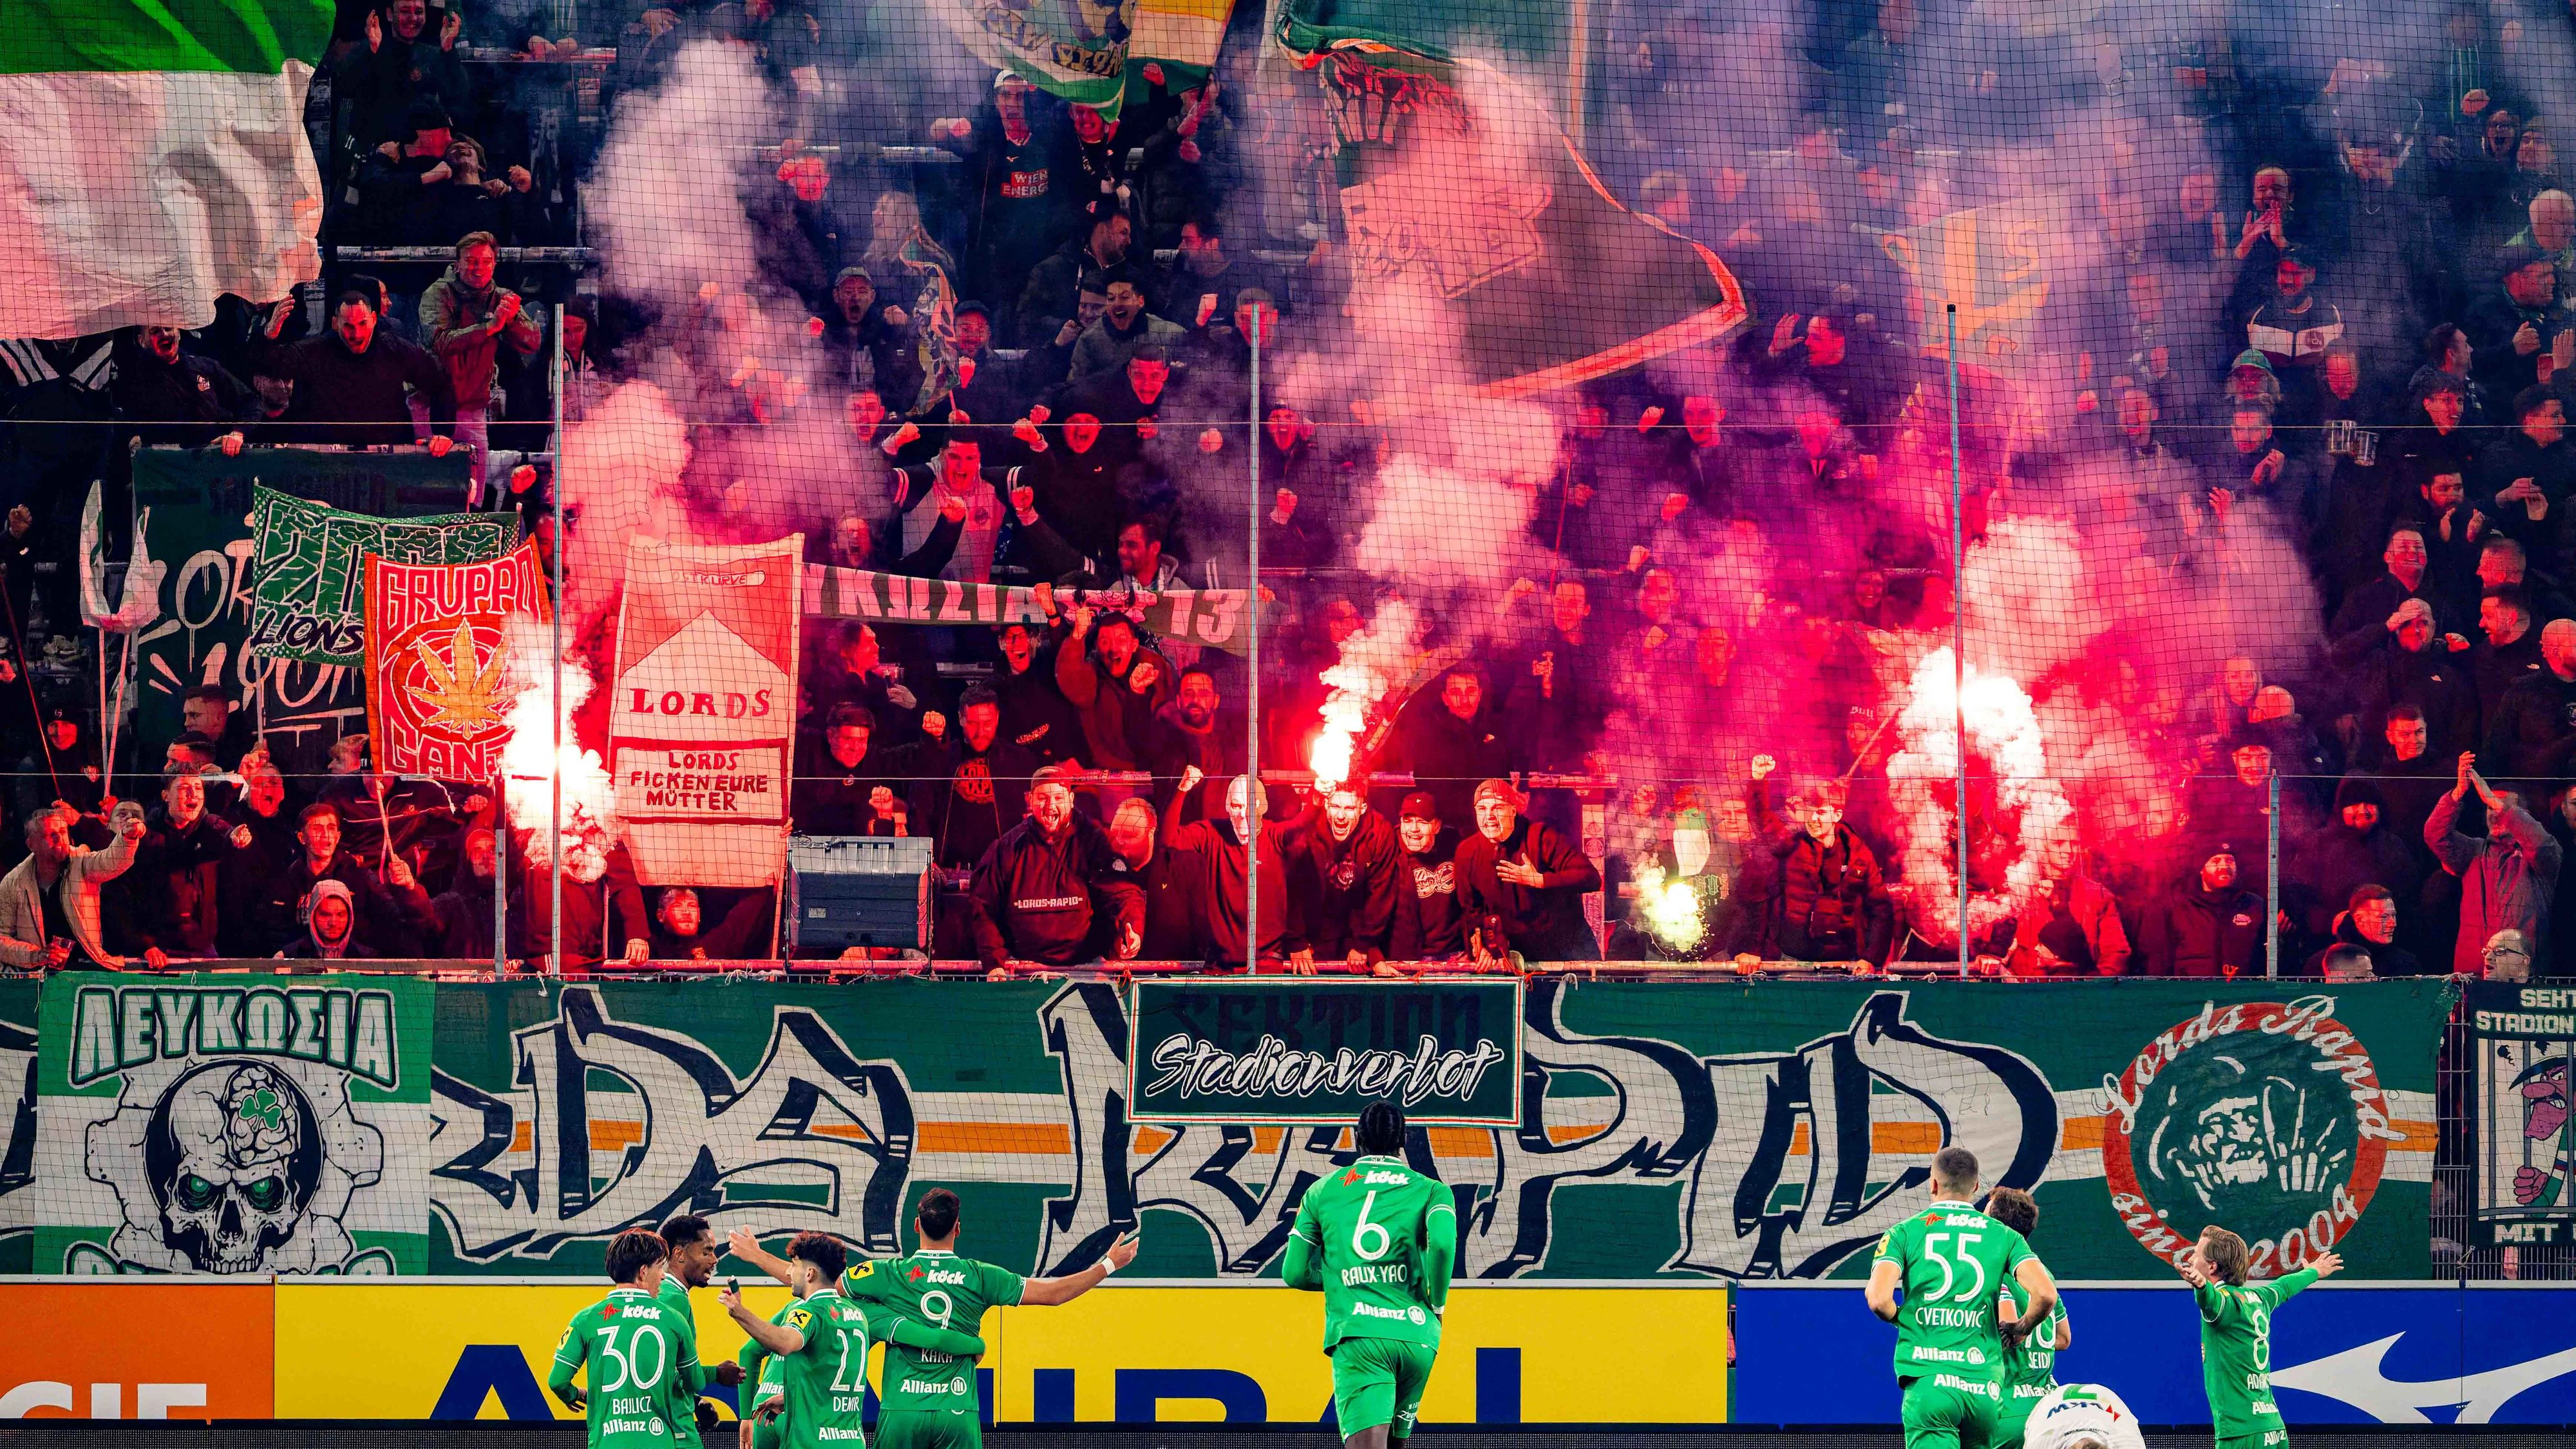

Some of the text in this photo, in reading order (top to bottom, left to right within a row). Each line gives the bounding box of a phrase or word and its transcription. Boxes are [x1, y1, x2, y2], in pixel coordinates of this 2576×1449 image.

[1014, 169, 1048, 184] WIEN
[1002, 182, 1049, 196] ENERG
[1162, 588, 1247, 644] 13
[249, 599, 365, 656] LIONS
[629, 687, 772, 719] LORDS
[668, 752, 741, 771] LORDS
[630, 771, 768, 793] FICKEN EURE
[646, 790, 737, 811] MÜTTER
[2476, 1010, 2575, 1034] STADION
[1146, 1033, 1504, 1107] Stadionverbot
[2091, 999, 2245, 1135] Lords
[1364, 1170, 1411, 1185] köck
[1353, 1190, 1390, 1260] 6
[1945, 1213, 1989, 1229] köck
[2112, 1182, 2360, 1279] sinc 2004
[2495, 1223, 2559, 1243] MIT
[927, 1269, 967, 1285] köck
[1341, 1264, 1408, 1287] RAUX-YAO
[1924, 1233, 1985, 1302] 55
[622, 1305, 662, 1320] köck
[920, 1290, 952, 1329] 9
[1352, 1302, 1407, 1320] Allianz
[1915, 1305, 1987, 1328] CVETKOVIĆ
[2252, 1309, 2269, 1370] 8
[597, 1324, 666, 1393] 30
[829, 1329, 866, 1392] 22
[1912, 1345, 1965, 1362] Allianz
[900, 1379, 949, 1394] Allianz
[1934, 1373, 1986, 1395] Allianz
[2013, 1384, 2051, 1398] Allian
[612, 1396, 652, 1416] BAJLICZ
[833, 1396, 860, 1412] DEMIR
[603, 1418, 646, 1437] Allianz
[819, 1426, 860, 1441] Allianz
